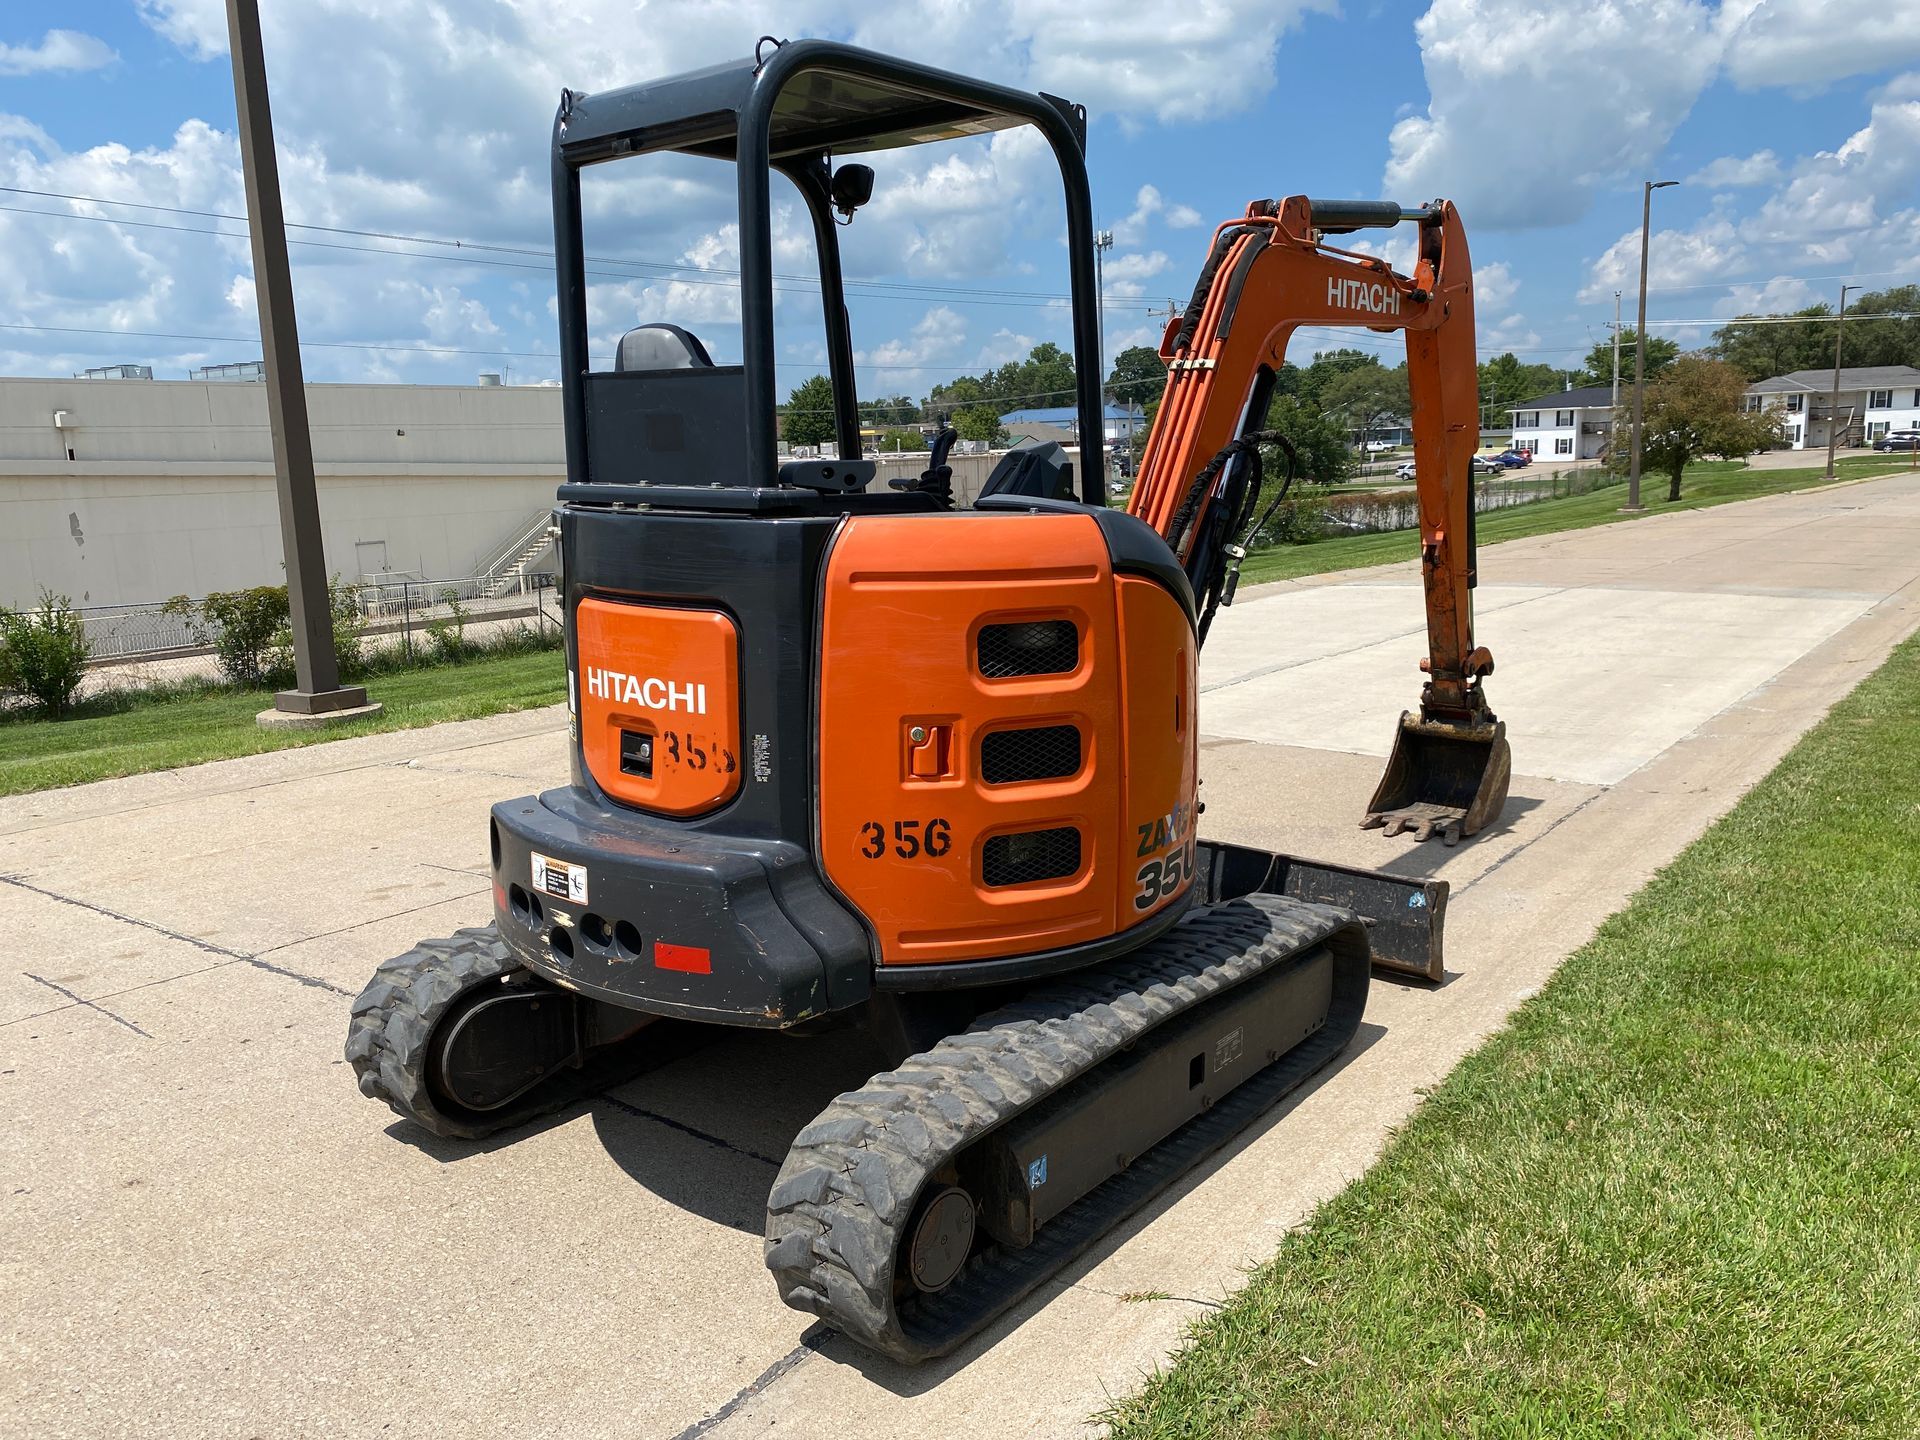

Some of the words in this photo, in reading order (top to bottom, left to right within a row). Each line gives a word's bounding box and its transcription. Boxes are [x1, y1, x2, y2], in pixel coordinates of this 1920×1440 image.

[1328, 277, 1400, 314] HITACHI
[587, 666, 706, 714] HITACHI
[861, 818, 952, 859] 356
